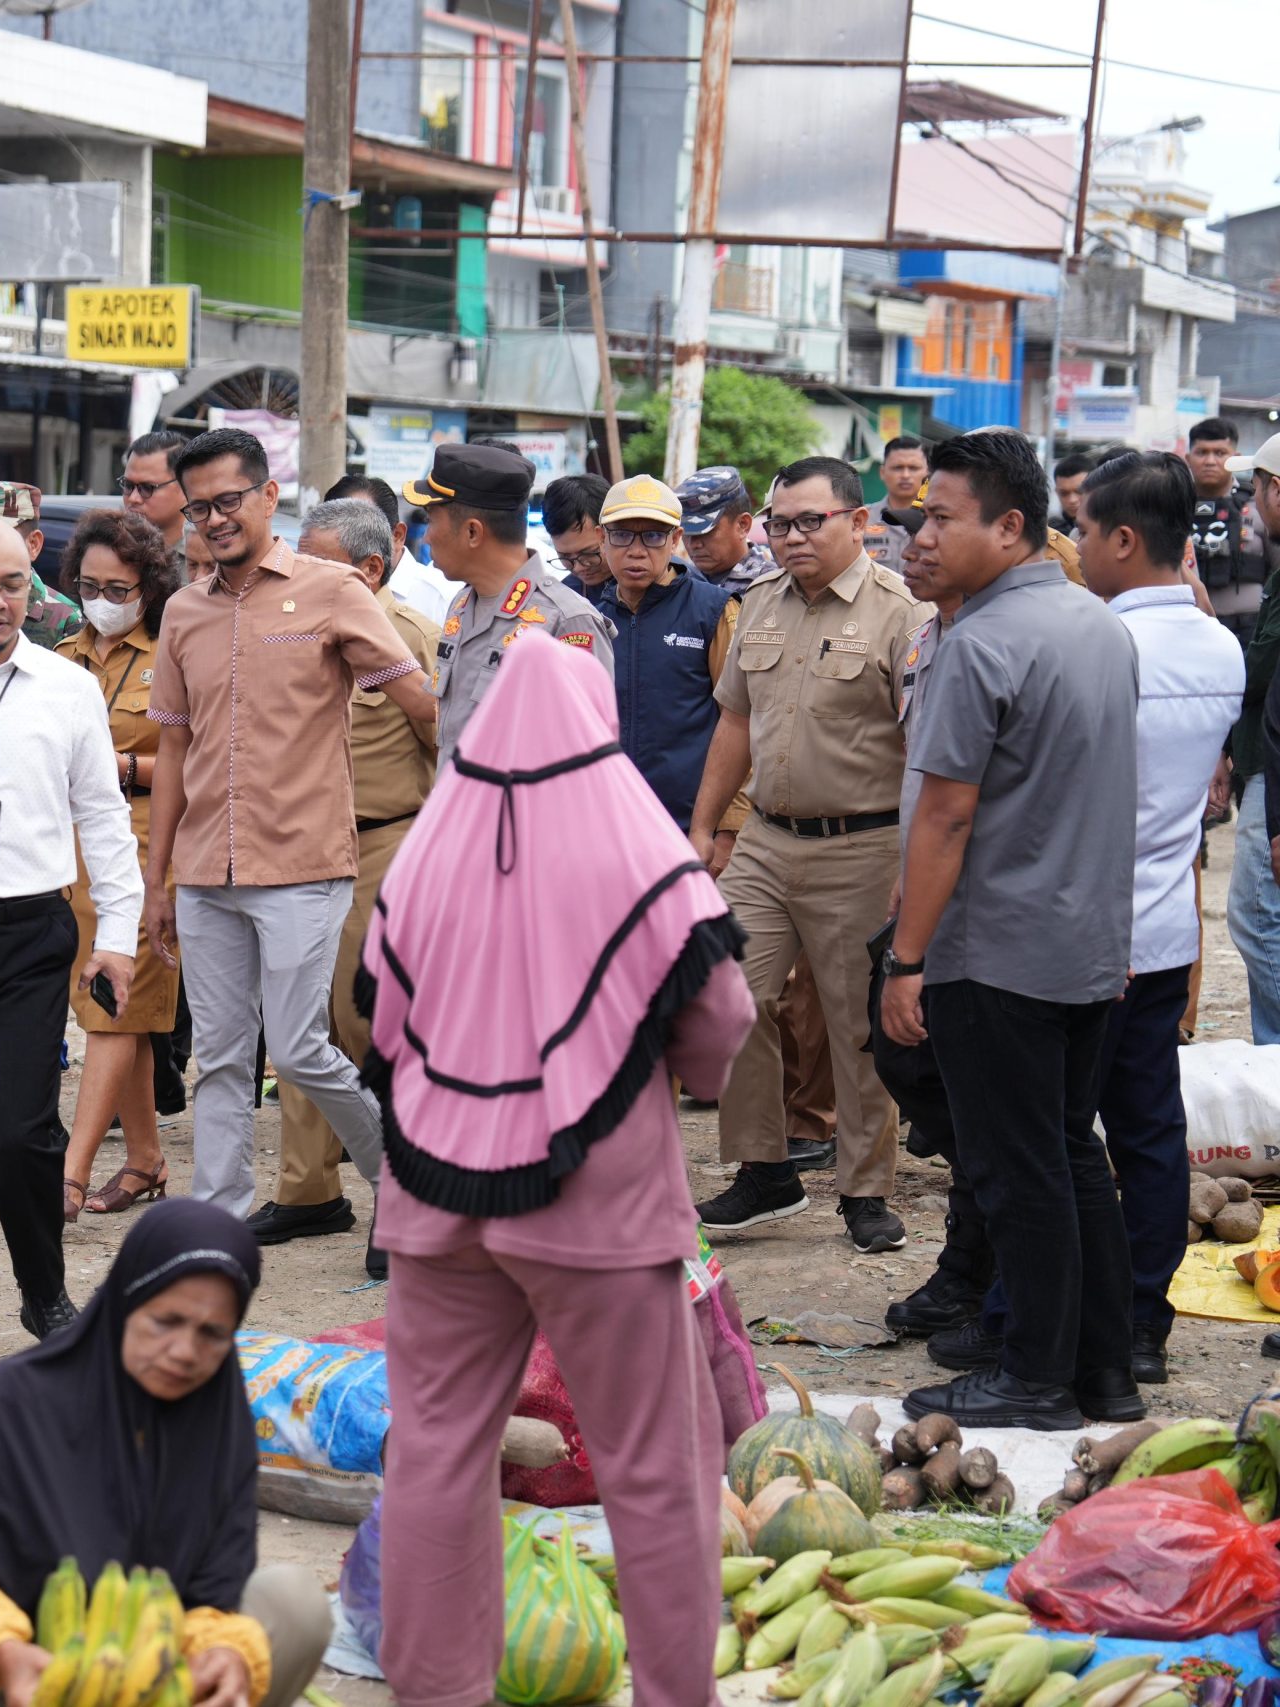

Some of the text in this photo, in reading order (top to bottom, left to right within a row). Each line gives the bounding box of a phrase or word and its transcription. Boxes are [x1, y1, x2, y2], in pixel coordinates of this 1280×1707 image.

[100, 293, 176, 316] APOTEK
[79, 323, 177, 349] SINAR WAJO
[747, 633, 784, 642] NAJIB ALI
